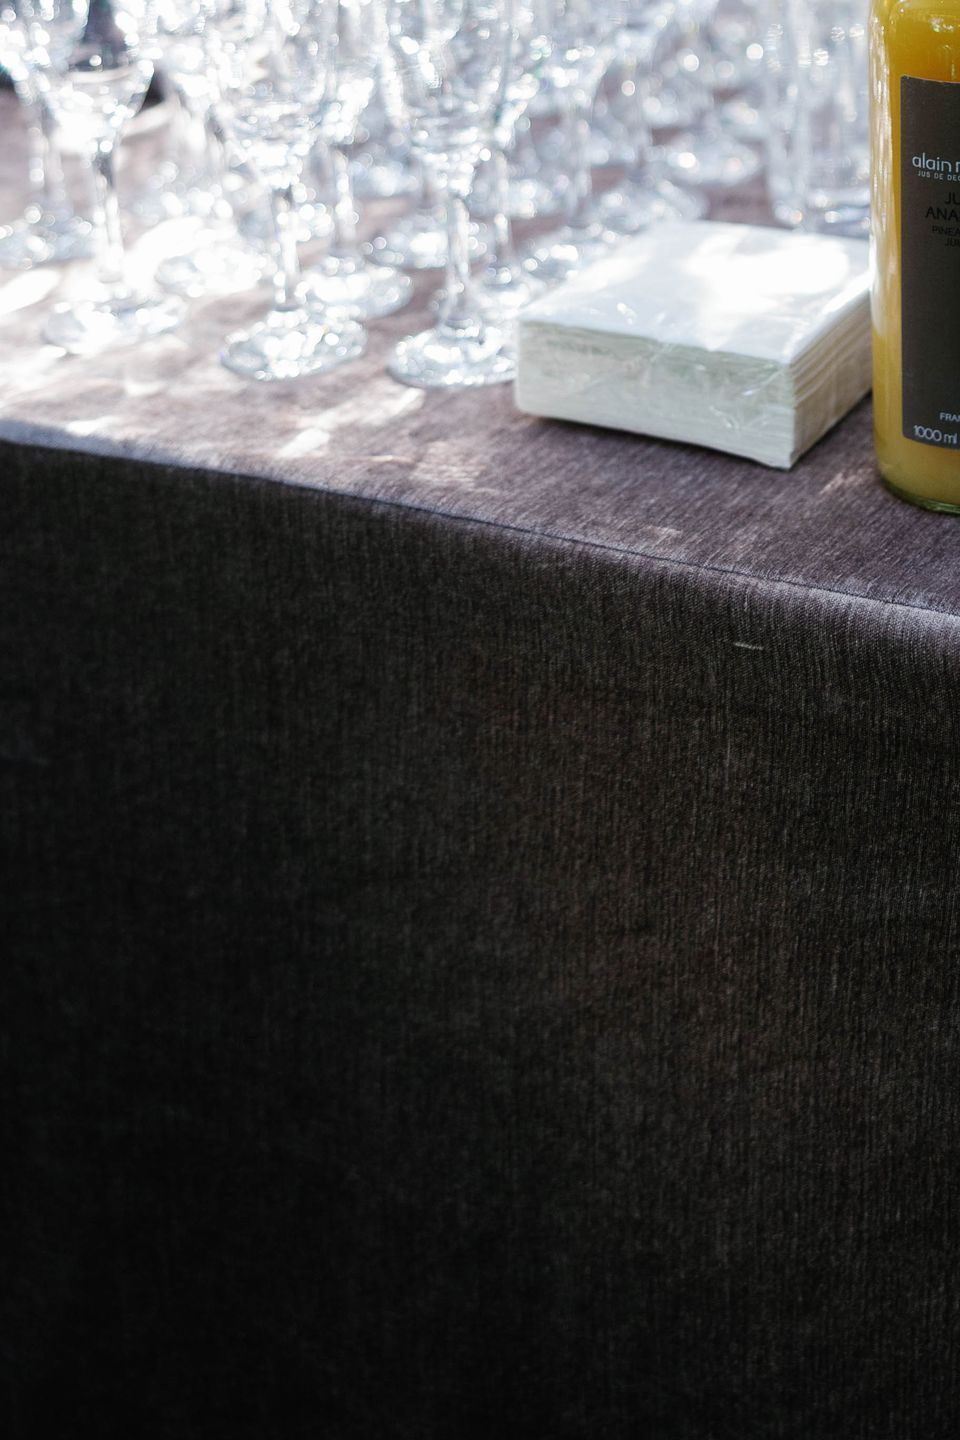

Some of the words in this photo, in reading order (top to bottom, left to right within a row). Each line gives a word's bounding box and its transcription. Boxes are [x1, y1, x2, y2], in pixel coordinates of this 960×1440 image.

[911, 152, 952, 173] alain
[914, 425, 942, 442] 1000
[943, 432, 957, 444] ml
